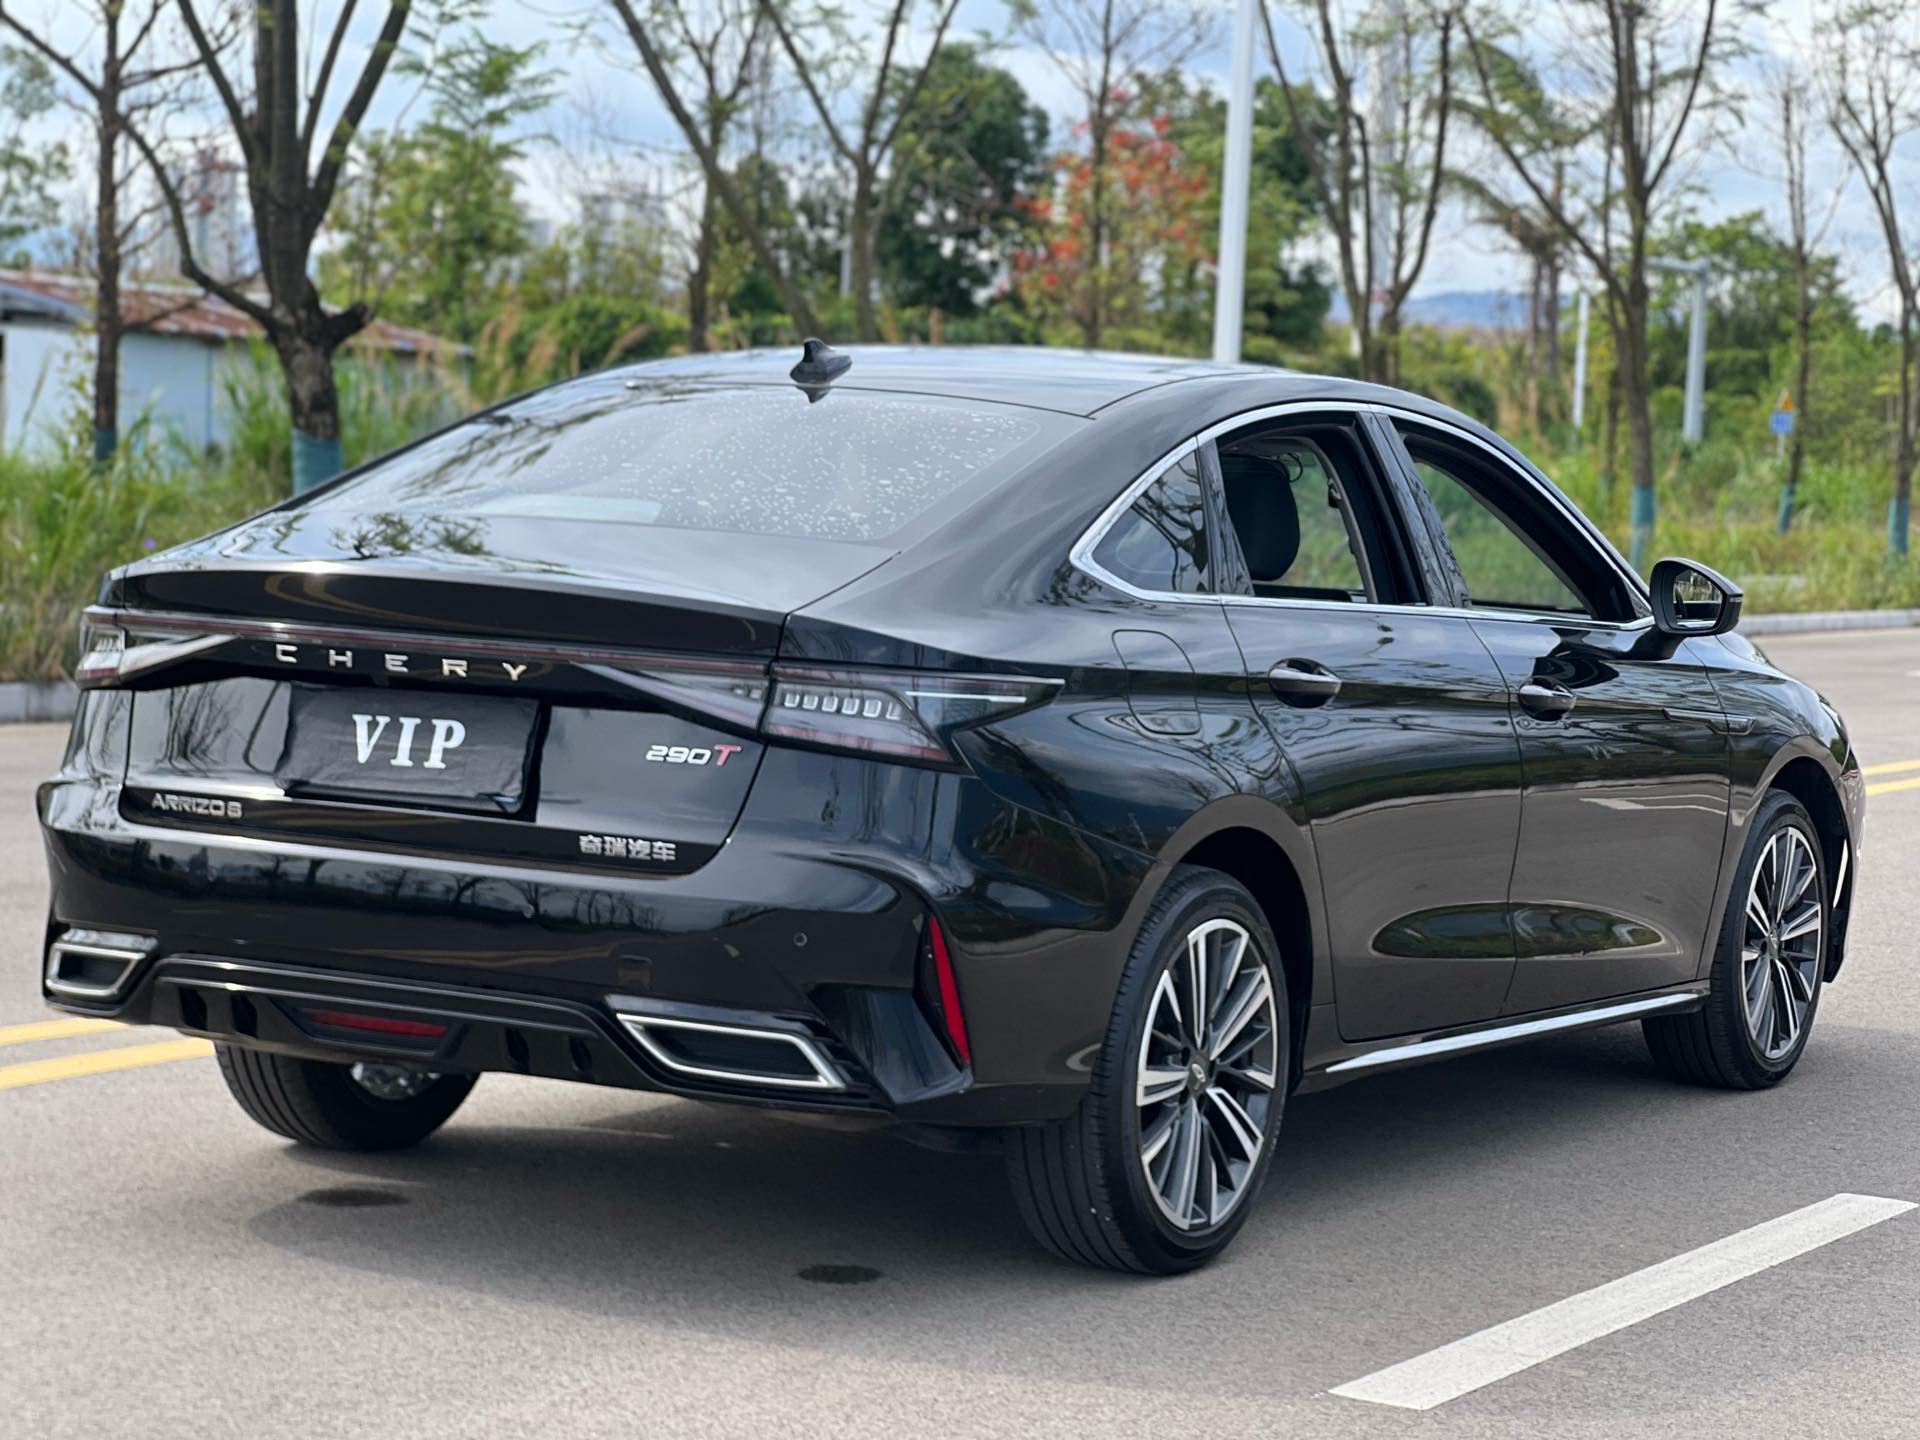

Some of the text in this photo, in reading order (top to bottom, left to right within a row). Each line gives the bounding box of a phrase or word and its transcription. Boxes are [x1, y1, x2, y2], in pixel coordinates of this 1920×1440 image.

[275, 643, 528, 681] CHERY
[352, 714, 466, 769] VIP
[646, 744, 742, 766] 290T
[578, 834, 676, 862] 奇瑞汽车
